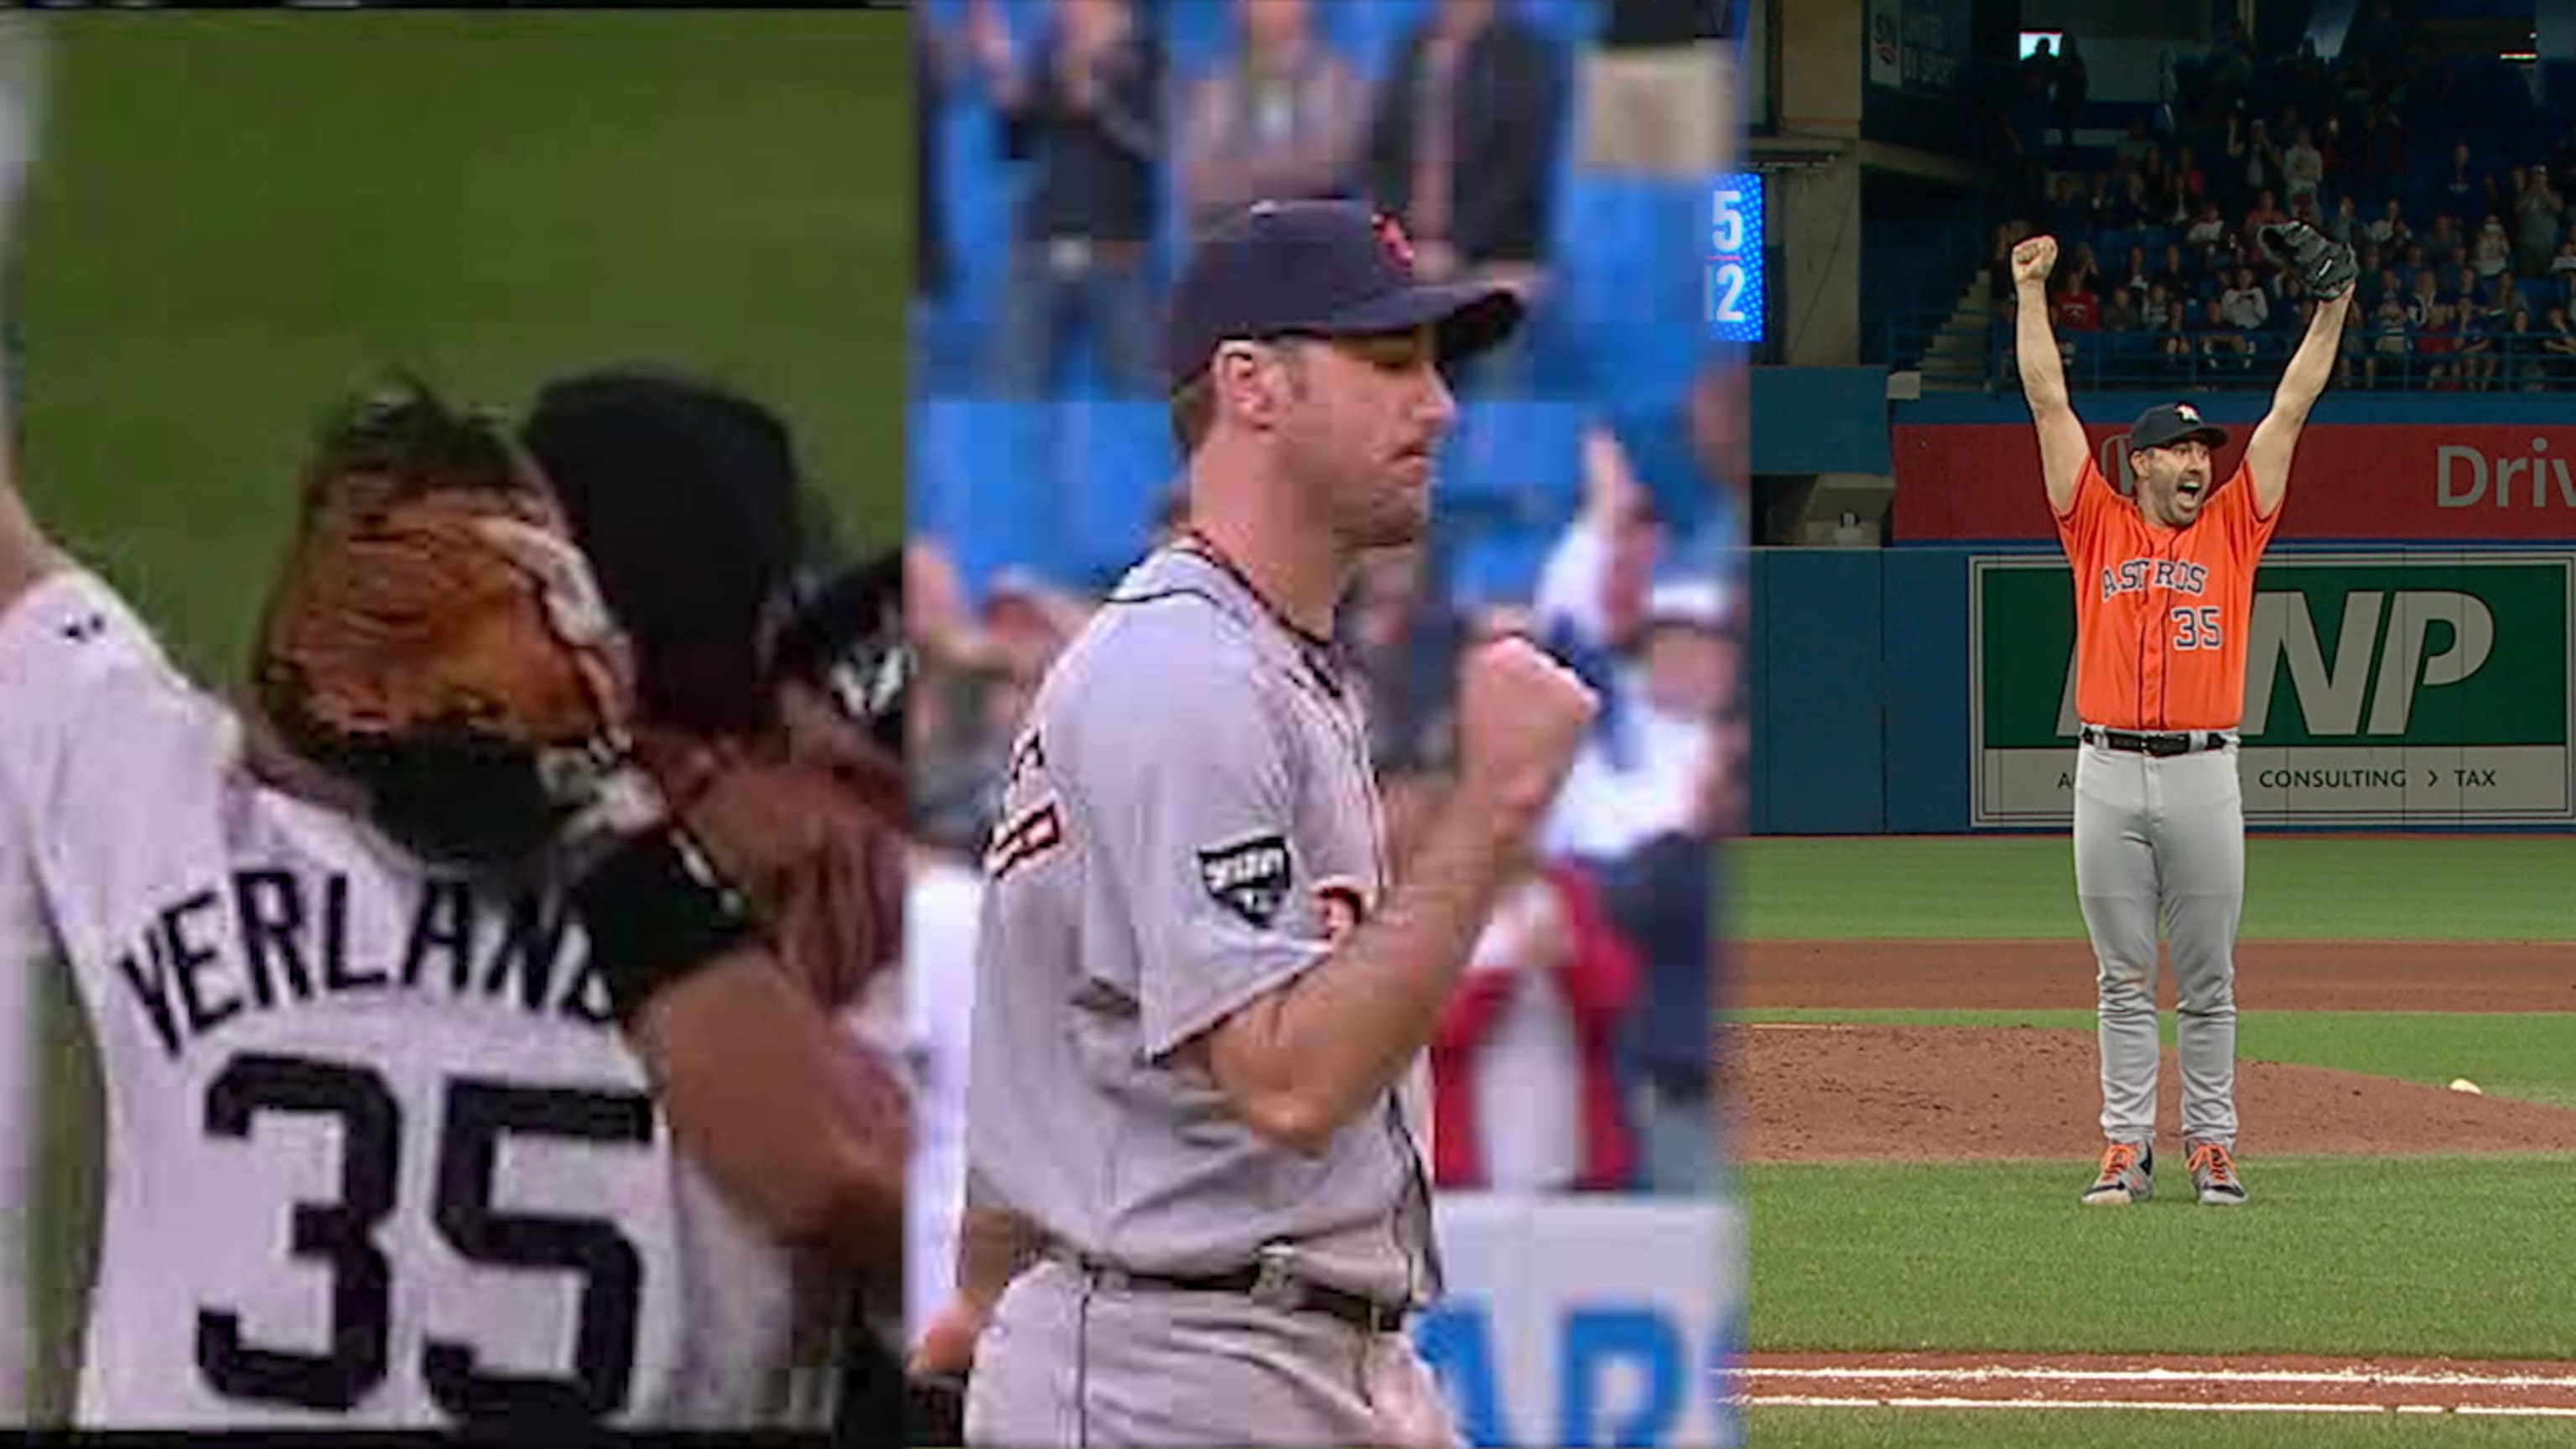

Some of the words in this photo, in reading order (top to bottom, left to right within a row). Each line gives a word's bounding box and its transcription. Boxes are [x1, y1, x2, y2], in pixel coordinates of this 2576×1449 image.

[1712, 190, 1743, 252] 5
[2437, 436, 2576, 508] Driv
[2101, 558, 2208, 603] ASTROS
[2171, 606, 2222, 651] 35
[2259, 770, 2406, 788] CONSULTING
[2454, 770, 2496, 787] TAX
[195, 1051, 653, 1429] 35
